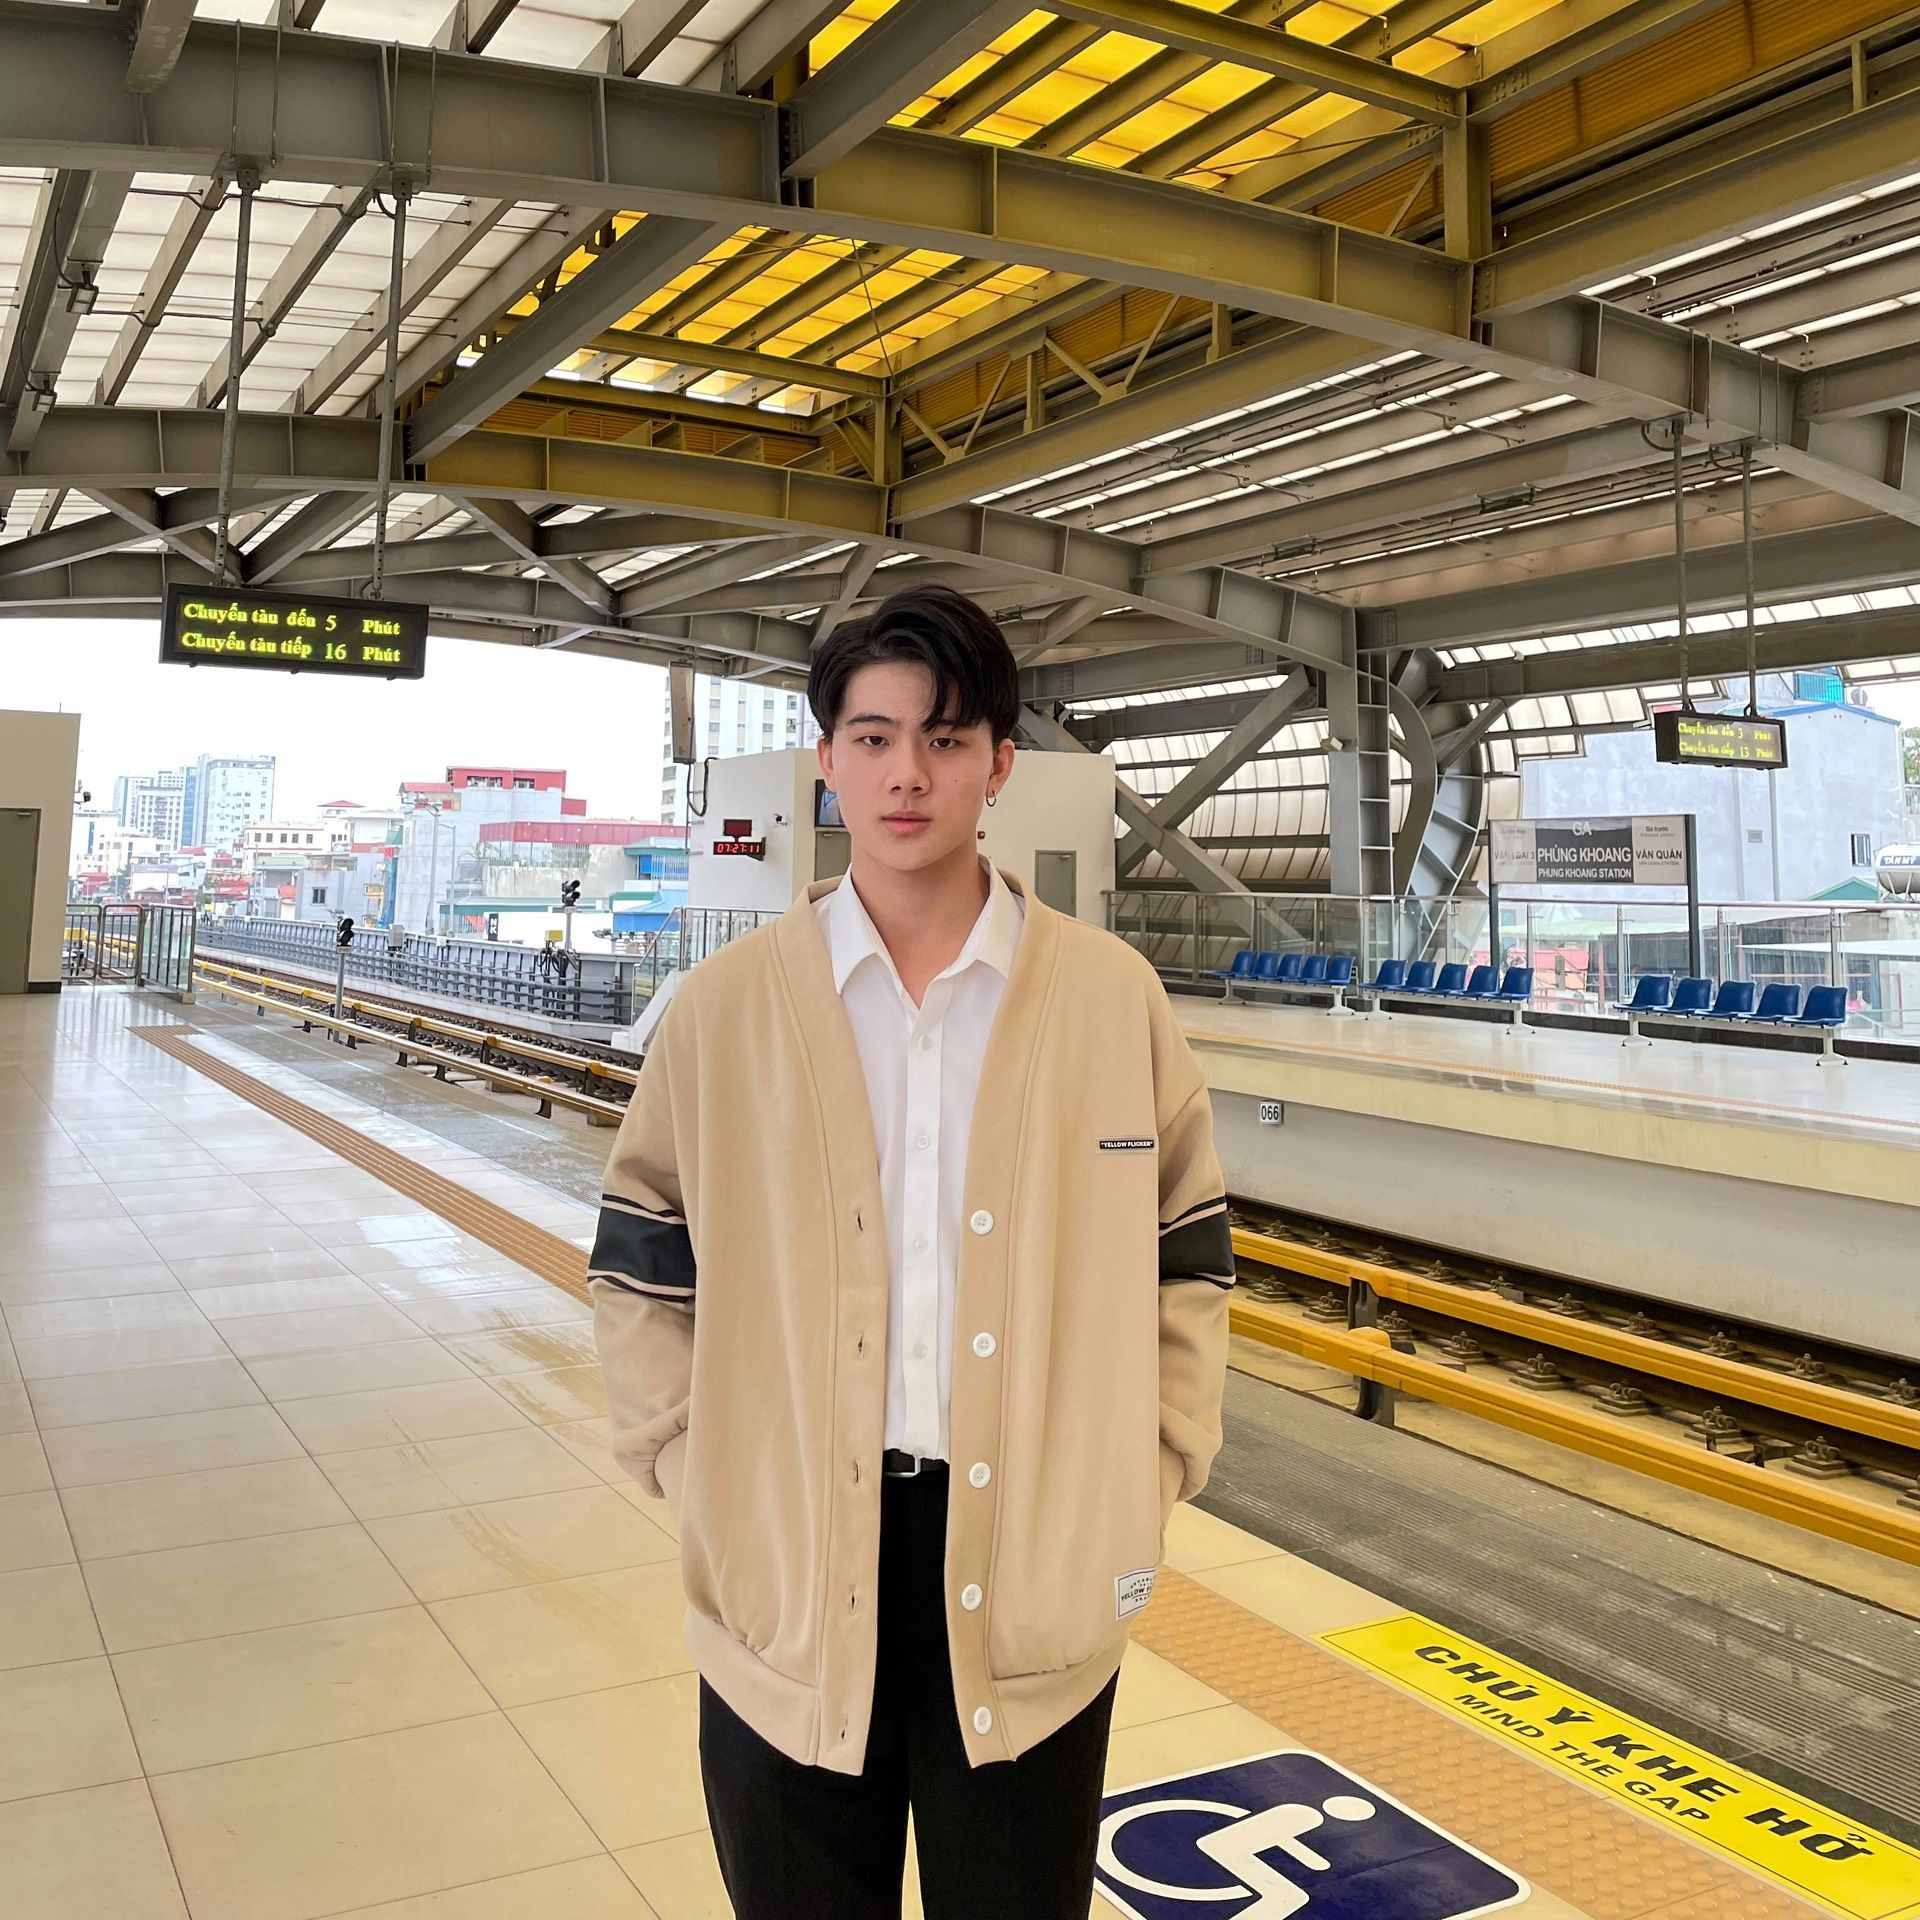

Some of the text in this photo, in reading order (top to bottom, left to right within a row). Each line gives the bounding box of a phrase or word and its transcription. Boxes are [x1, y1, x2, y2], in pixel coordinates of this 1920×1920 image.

[183, 602, 401, 636] Chuyến tàu đến 5 Phút
[182, 631, 401, 662] Chuyến tàu tiếp 16 Phút
[1573, 821, 1593, 836] GA
[1537, 844, 1632, 863] PHÙNG KHOANG
[1538, 868, 1632, 878] PHUNG KHOANG STATION
[1261, 1105, 1279, 1121] 066
[1121, 1587, 1145, 1602] YELLOW
[1414, 1645, 1875, 1861] CHÚ Ý KHE HỞ
[1453, 1693, 1711, 1822] MIND THE GAP
